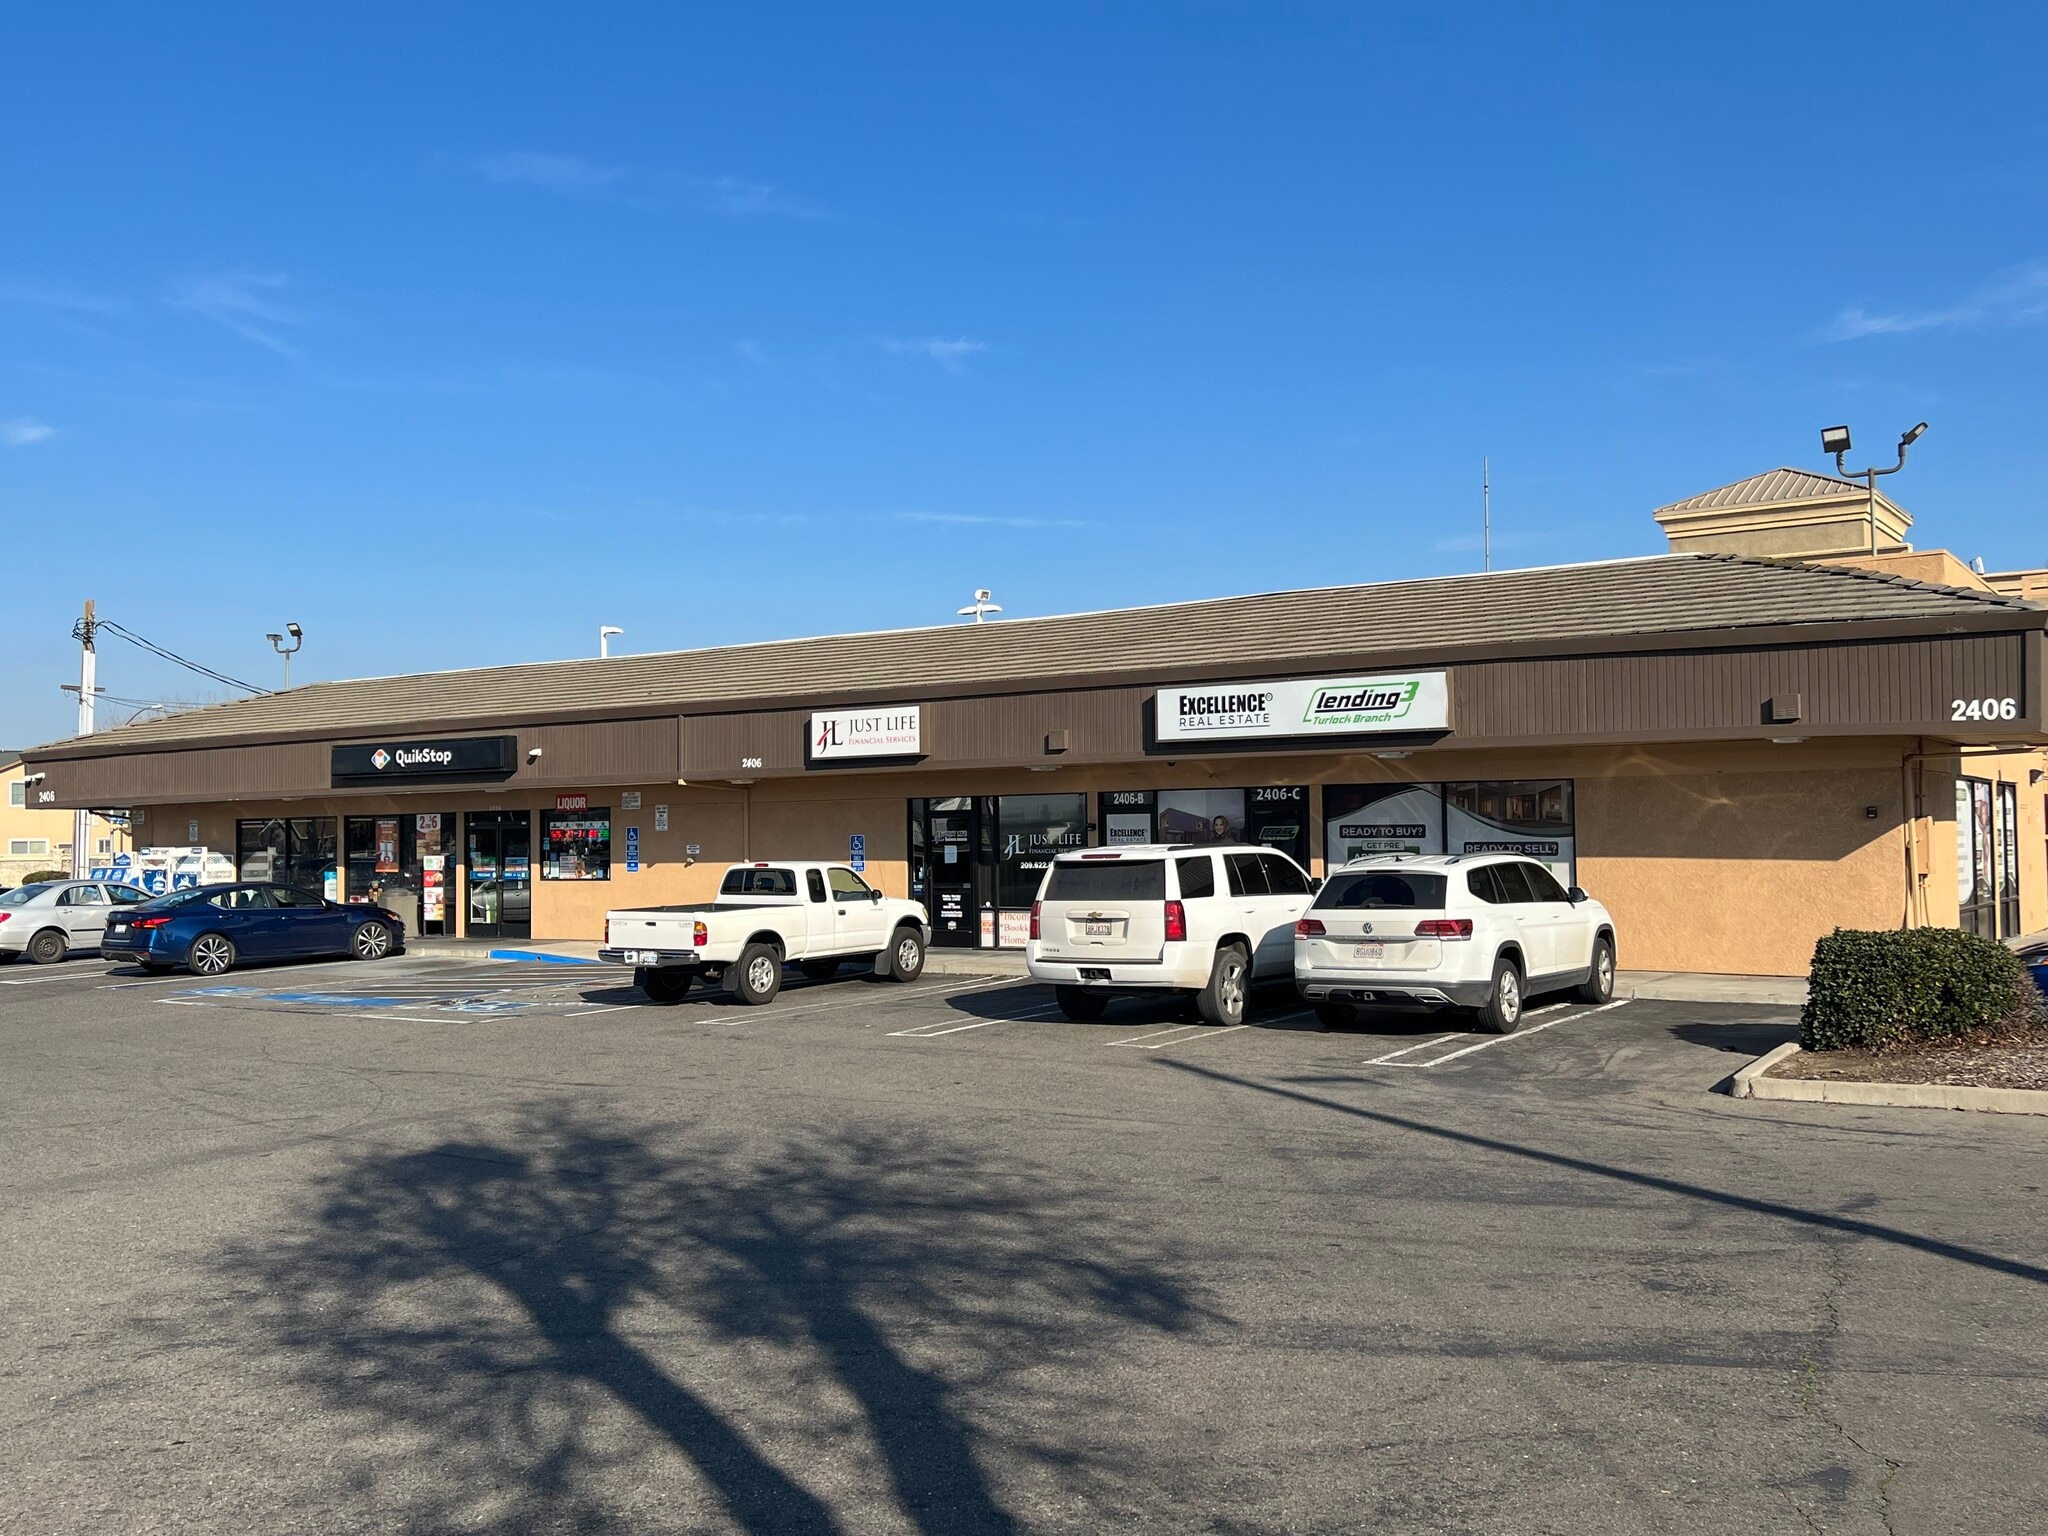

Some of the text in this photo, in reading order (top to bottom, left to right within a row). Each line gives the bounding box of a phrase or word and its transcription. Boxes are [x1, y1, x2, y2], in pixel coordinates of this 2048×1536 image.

[1179, 693, 1267, 716] EXCELLENCE
[1951, 697, 2017, 721] 2406
[1179, 713, 1270, 727] REAL ESTATE
[1313, 712, 1392, 725] Turlock Branch
[849, 715, 916, 736] JUST LIFE
[849, 735, 916, 745] FINANCIAL SERVICES
[395, 748, 452, 767] QuikStop
[742, 757, 762, 768] 2406
[39, 790, 55, 803] 2406
[1113, 792, 1144, 804] 2406-B
[1256, 787, 1300, 800] 2406-C
[556, 797, 586, 809] LIQUOR
[420, 815, 425, 829] 2
[1342, 827, 1423, 836] READY TO BUY?
[1029, 833, 1082, 847] JUST LIFE
[1524, 844, 1557, 853] SELL?
[1020, 861, 1052, 869] 209.622.
[1004, 911, 1030, 920] Incom
[1004, 923, 1030, 931] Bookk
